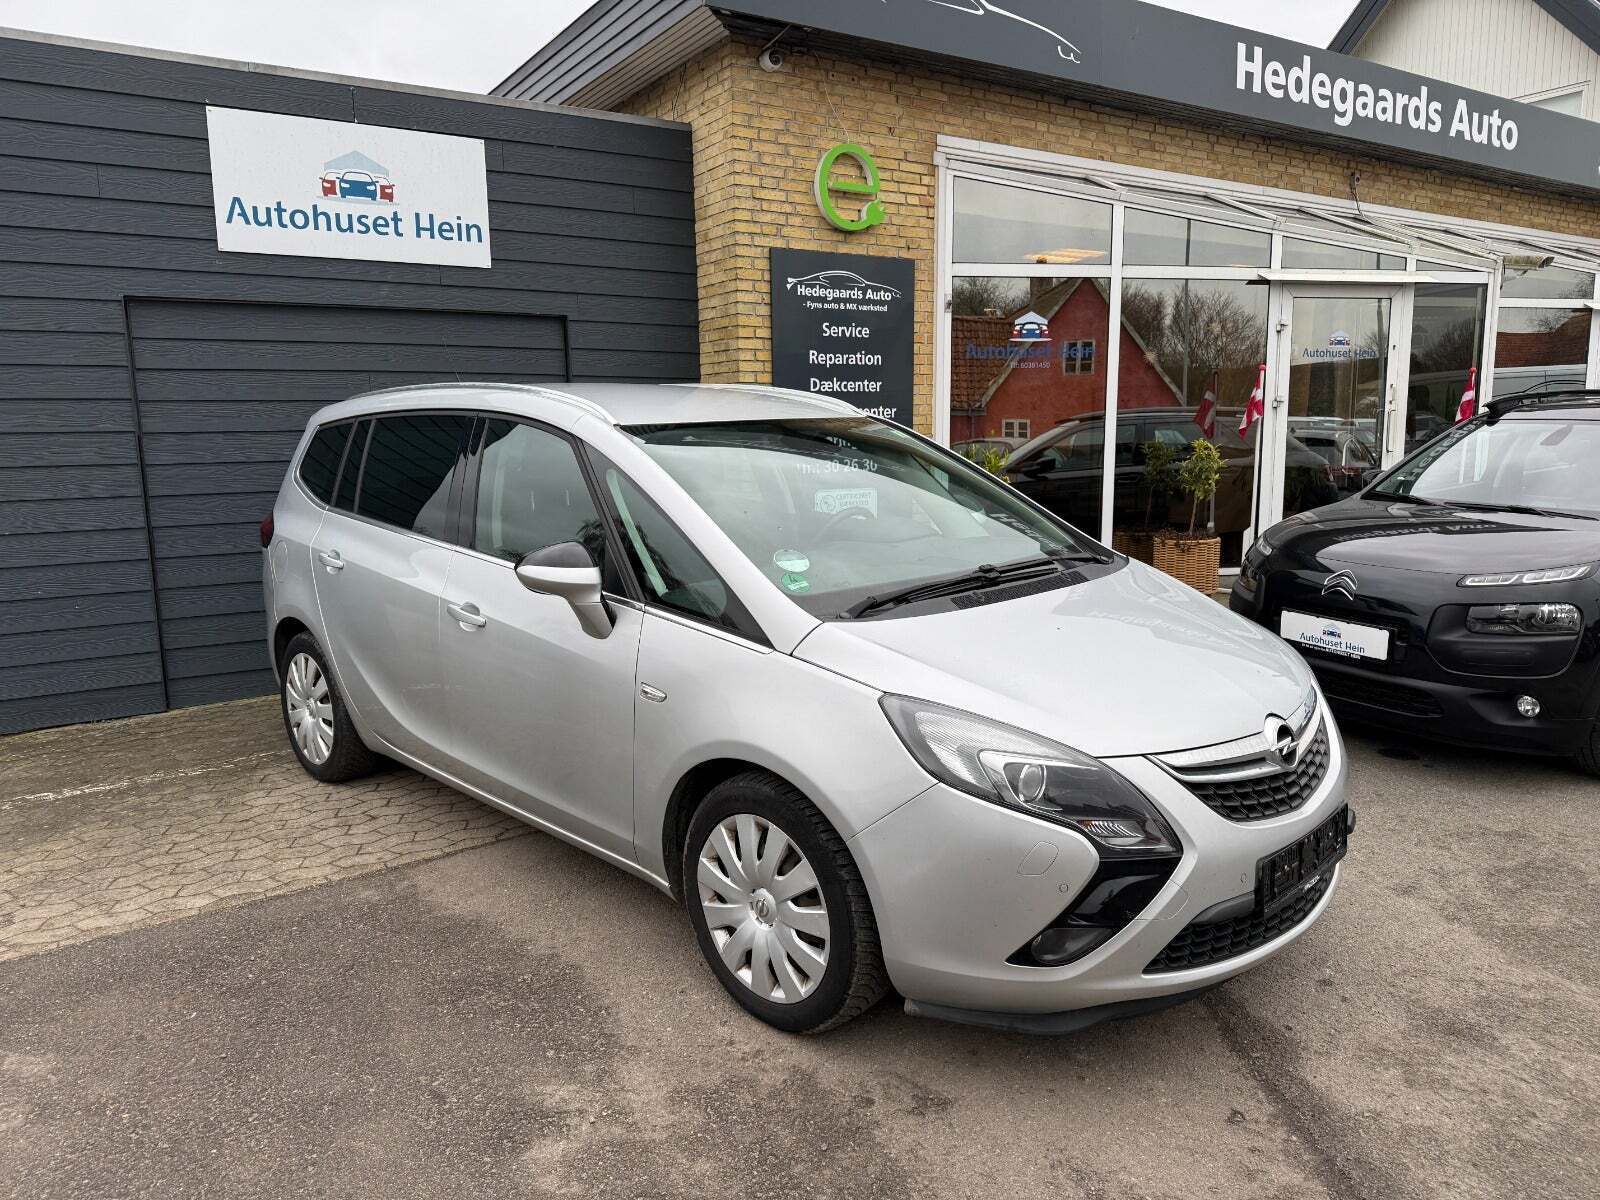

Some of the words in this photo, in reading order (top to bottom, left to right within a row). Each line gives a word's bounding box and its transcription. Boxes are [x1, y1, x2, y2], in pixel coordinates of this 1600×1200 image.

[1236, 42, 1442, 133] Hedegaards
[1449, 98, 1519, 151] Auto
[225, 196, 405, 238] Autohuset
[414, 211, 483, 244] Hein
[797, 284, 863, 300] Hedegaards
[865, 288, 892, 301] Auto
[806, 301, 822, 309] Fyns
[858, 304, 888, 312] værksted
[822, 322, 870, 338] Service
[809, 350, 882, 368] Reparation
[1302, 347, 1352, 358] Autohuset
[1354, 348, 1377, 358] Hein
[810, 377, 883, 392] Dækcenter
[1300, 632, 1343, 648] Autohuset
[1345, 642, 1365, 653] Hein
